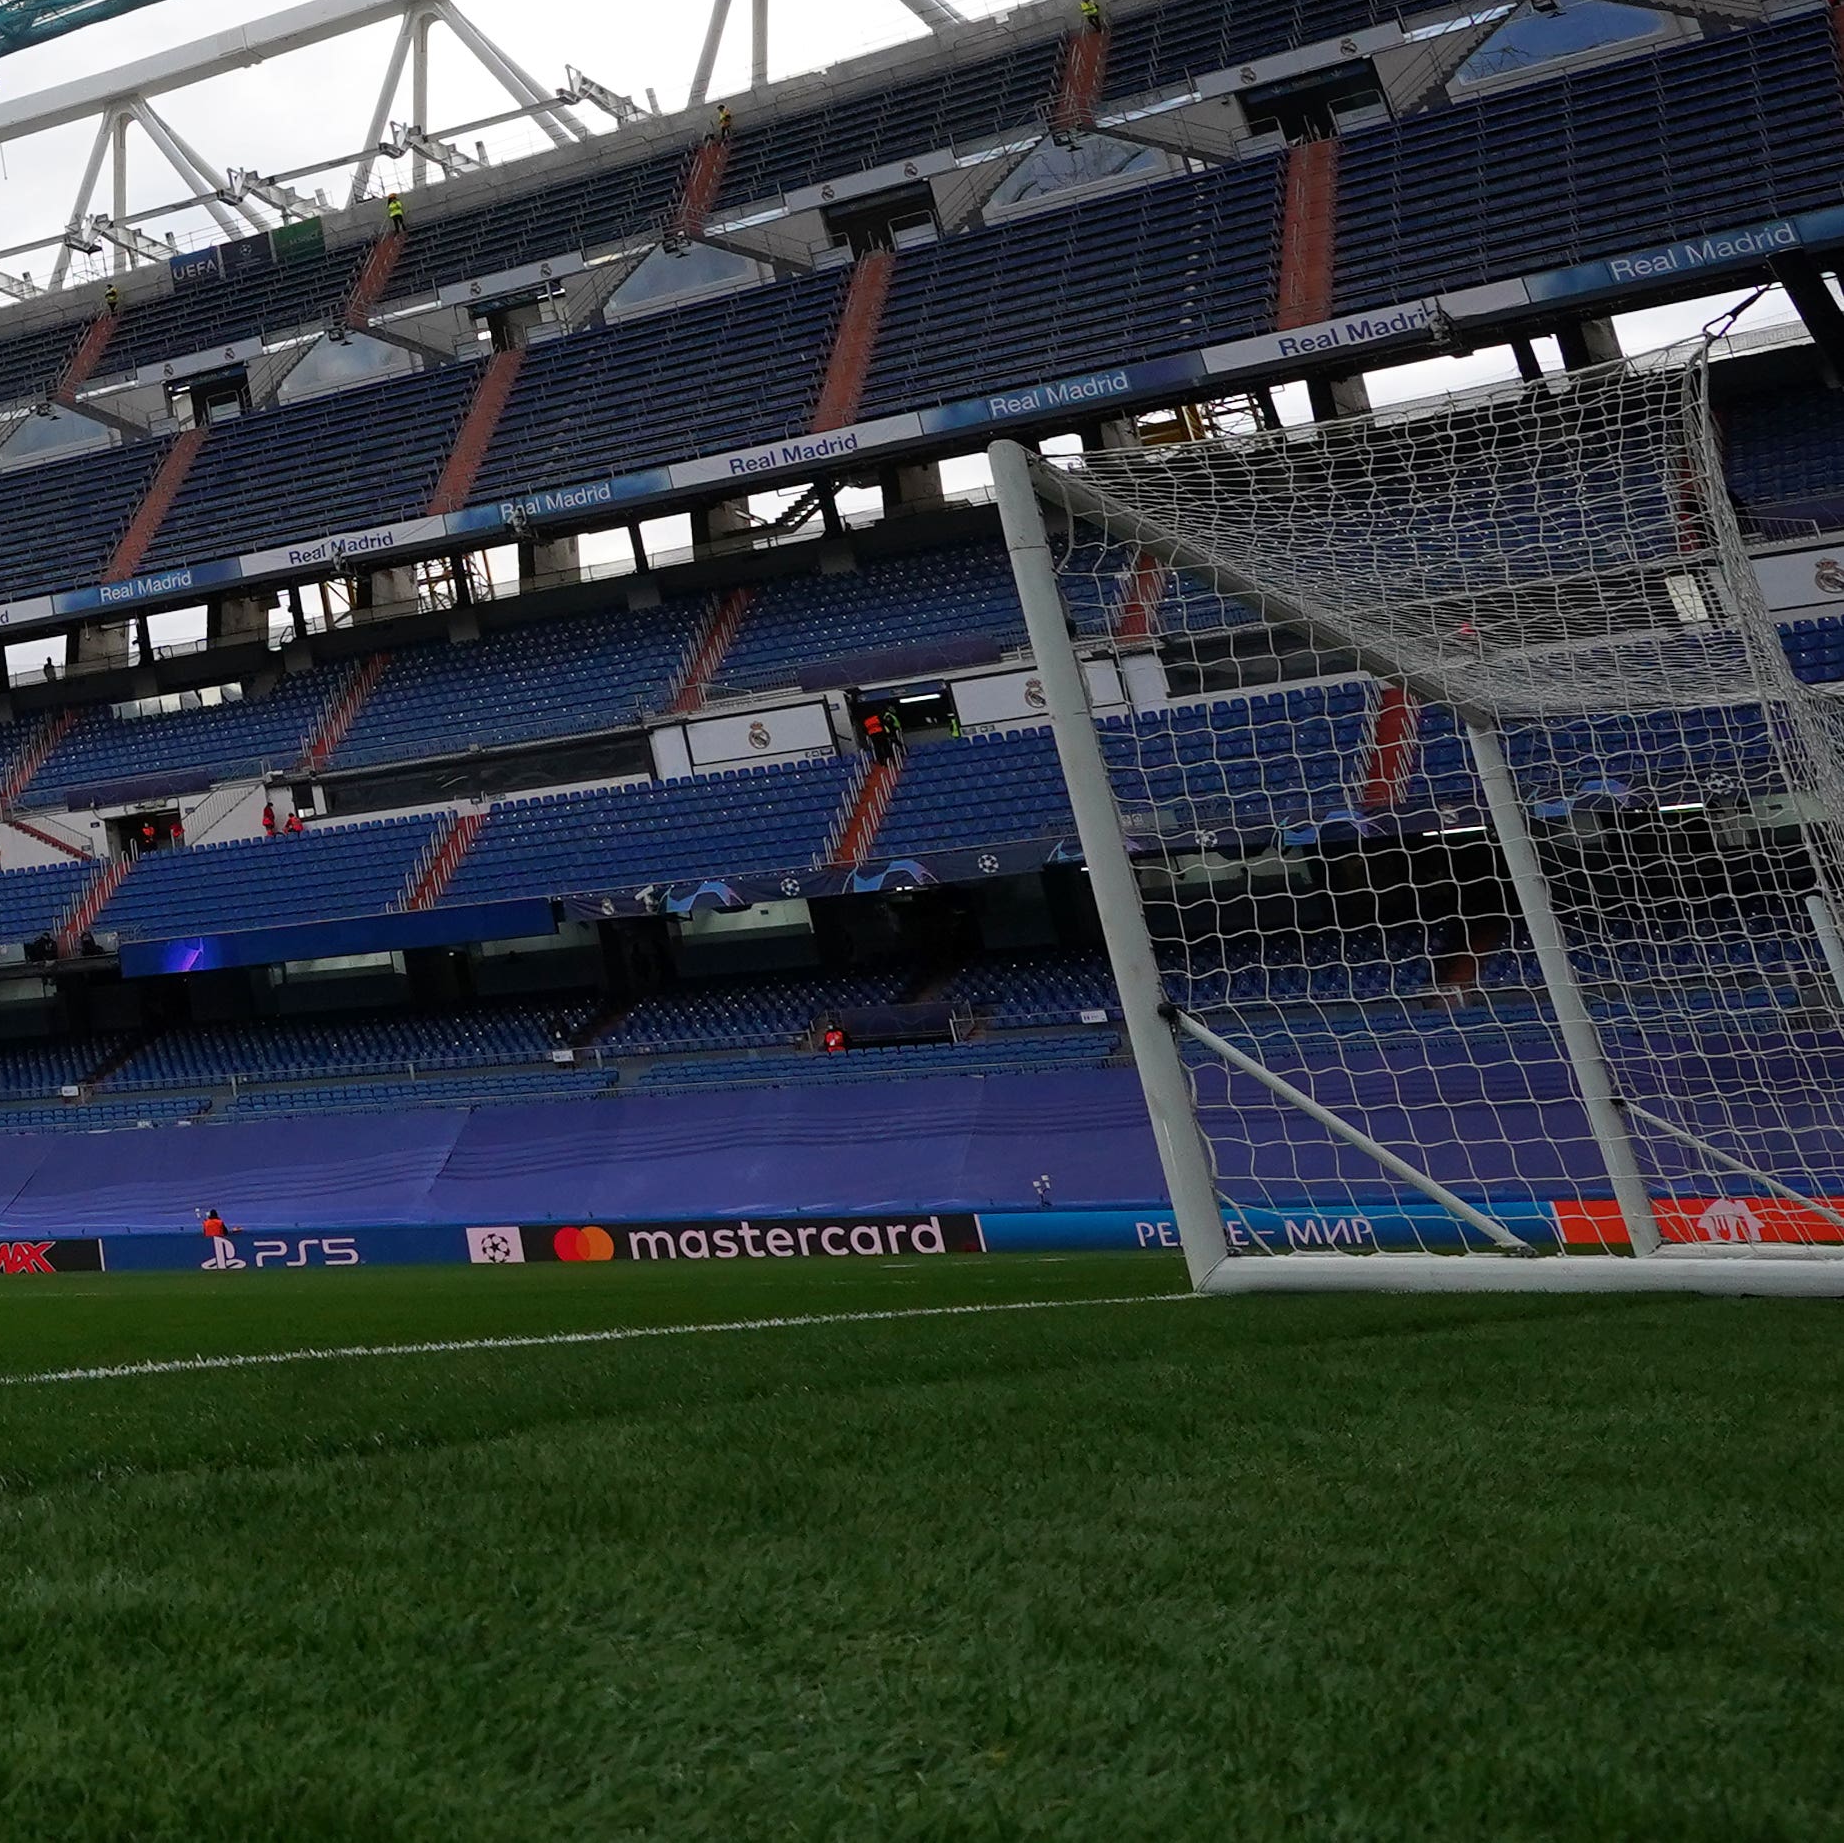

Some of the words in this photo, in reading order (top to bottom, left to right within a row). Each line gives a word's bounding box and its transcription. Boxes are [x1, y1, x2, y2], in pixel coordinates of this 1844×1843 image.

[1611, 248, 1679, 281] Real
[1690, 223, 1796, 263] Madrid
[173, 259, 217, 281] UEFA
[1278, 327, 1338, 356] Real
[1345, 308, 1427, 342] Madri
[990, 391, 1040, 416] Real
[1046, 373, 1129, 405] Madrid
[730, 452, 777, 474] Real
[783, 434, 857, 463] Madrid
[545, 484, 610, 511] Madrid
[289, 545, 326, 564] Real
[331, 532, 393, 554] Madrid
[100, 582, 134, 602] Real
[138, 572, 191, 595] Madrid
[629, 1216, 945, 1260] mastercard
[1284, 1218, 1372, 1246] МИР
[254, 1238, 359, 1267] PS5
